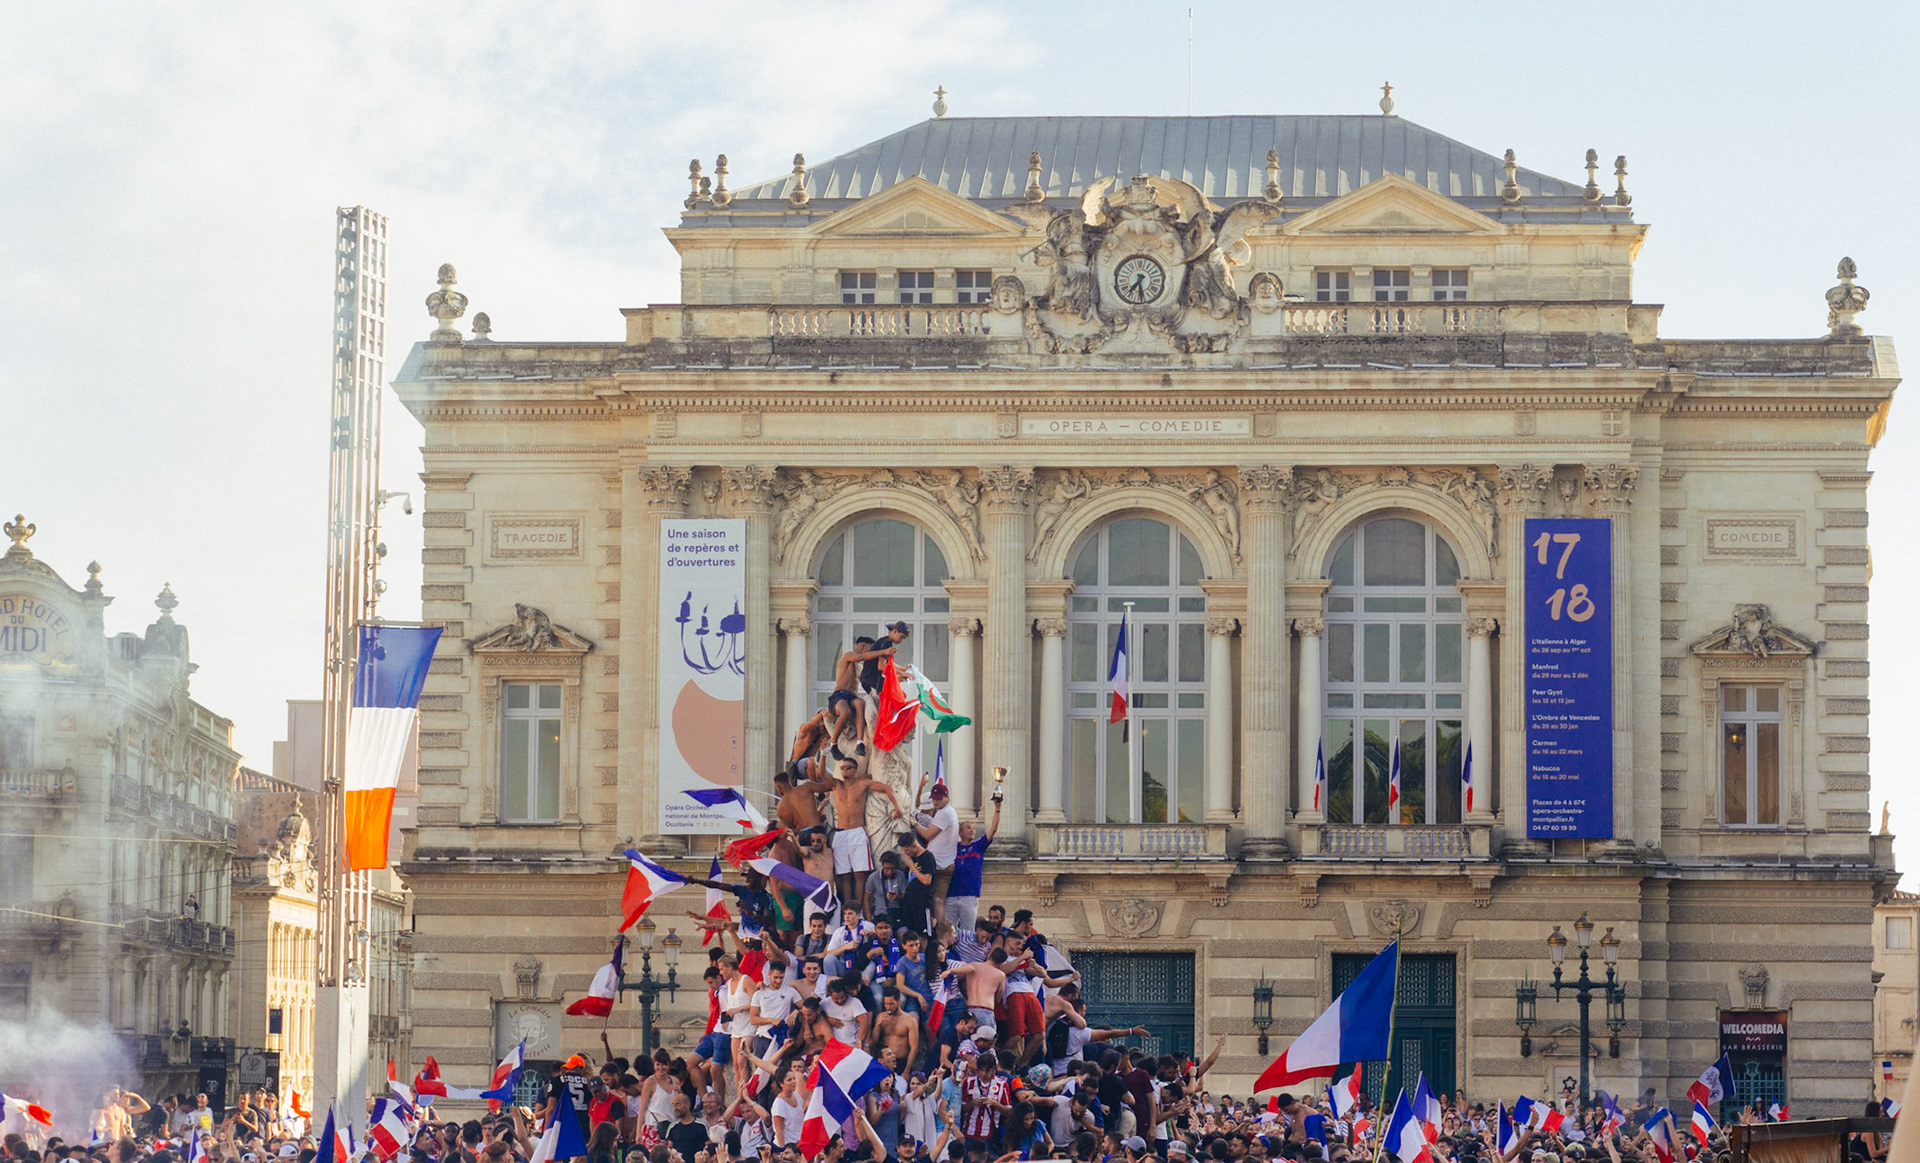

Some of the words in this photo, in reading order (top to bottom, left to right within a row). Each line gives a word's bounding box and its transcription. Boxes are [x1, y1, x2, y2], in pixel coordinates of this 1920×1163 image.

[1050, 421, 1108, 432] OPERA
[1140, 421, 1222, 432] COMEDIE
[504, 534, 566, 542] TRAGEDIE
[668, 529, 689, 538] Une
[692, 528, 726, 538] saison
[1720, 534, 1782, 542] COMEDIE
[667, 544, 681, 552] de
[684, 543, 726, 554] repères
[728, 544, 740, 552] et
[1532, 532, 1581, 580] 17
[1546, 584, 1595, 622] 18
[11, 616, 24, 624] DU
[21, 600, 68, 640] HOTEL
[1722, 1024, 1784, 1034] WELCOMEDIA
[569, 1082, 588, 1110] 5
